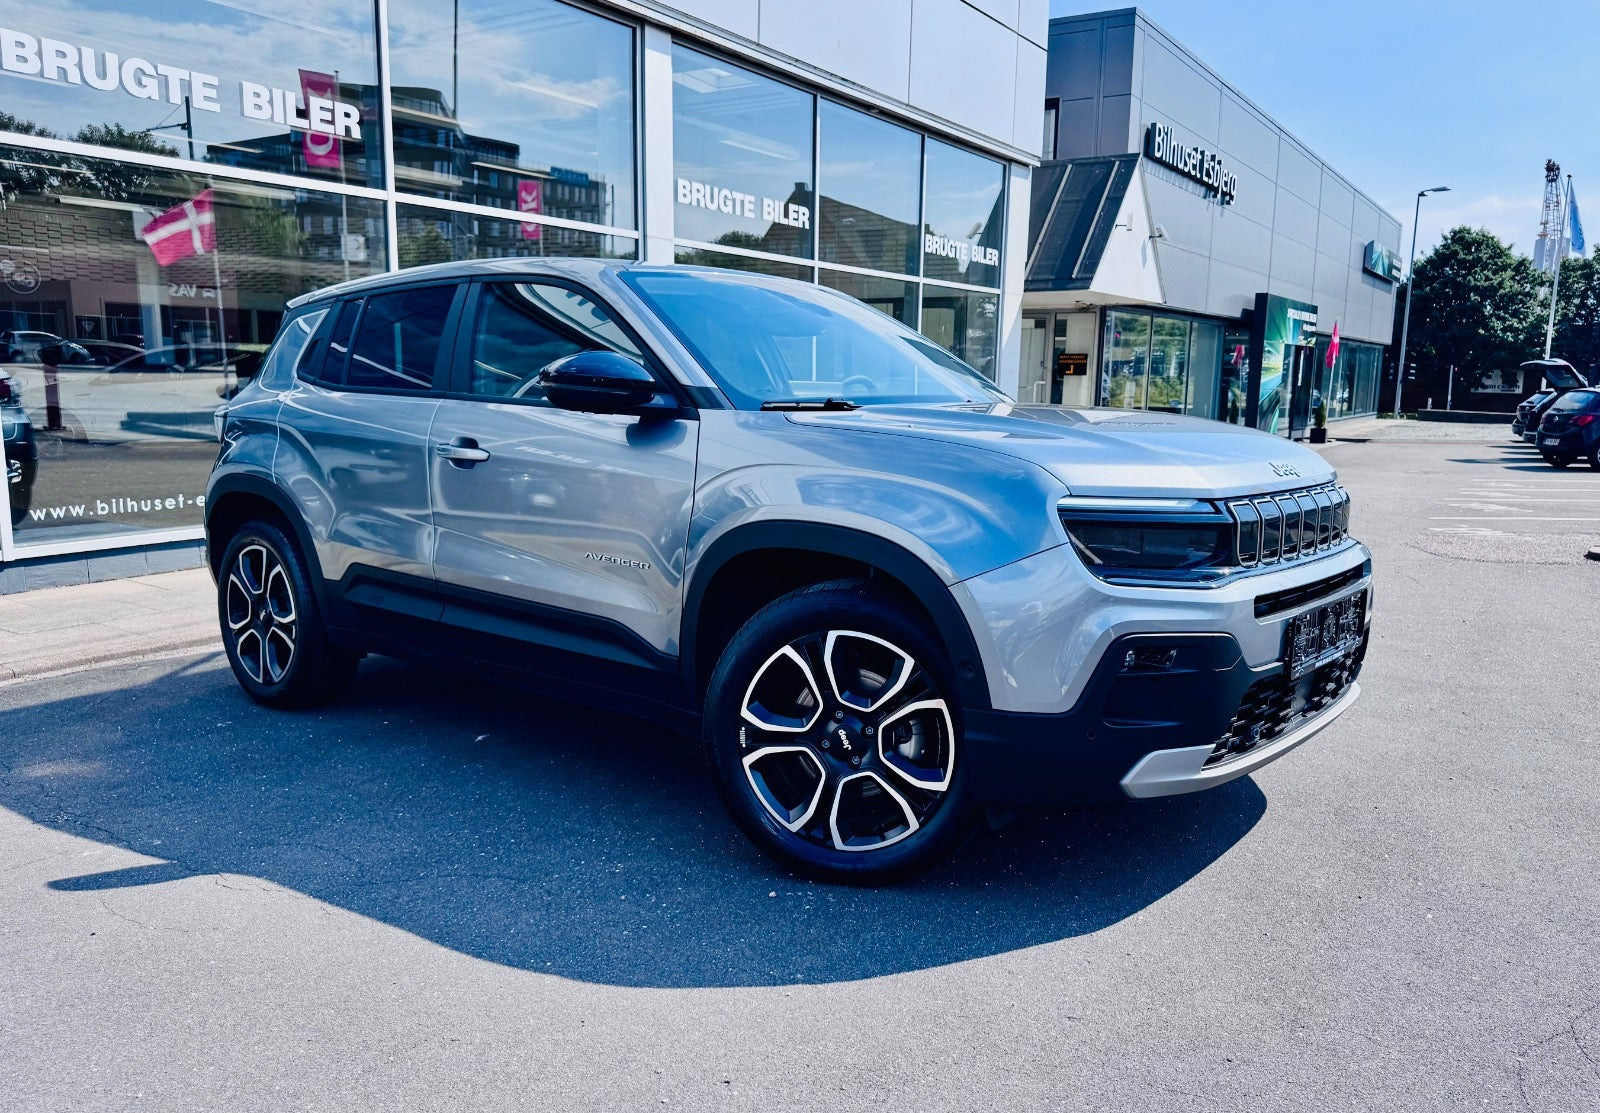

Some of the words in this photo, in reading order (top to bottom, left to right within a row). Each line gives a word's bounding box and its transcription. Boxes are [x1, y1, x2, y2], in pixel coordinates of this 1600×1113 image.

[0, 27, 221, 113] BRUGTE
[240, 80, 362, 140] BILER
[1154, 122, 1202, 179] Bilhuset
[1202, 150, 1238, 205] Esbjerg
[677, 178, 756, 219] BRUGTE
[762, 197, 810, 230] BILER
[925, 233, 968, 262] BRUGTE
[971, 245, 999, 267] BILER
[584, 551, 651, 571] AVENGER
[838, 729, 852, 750] Jeep
